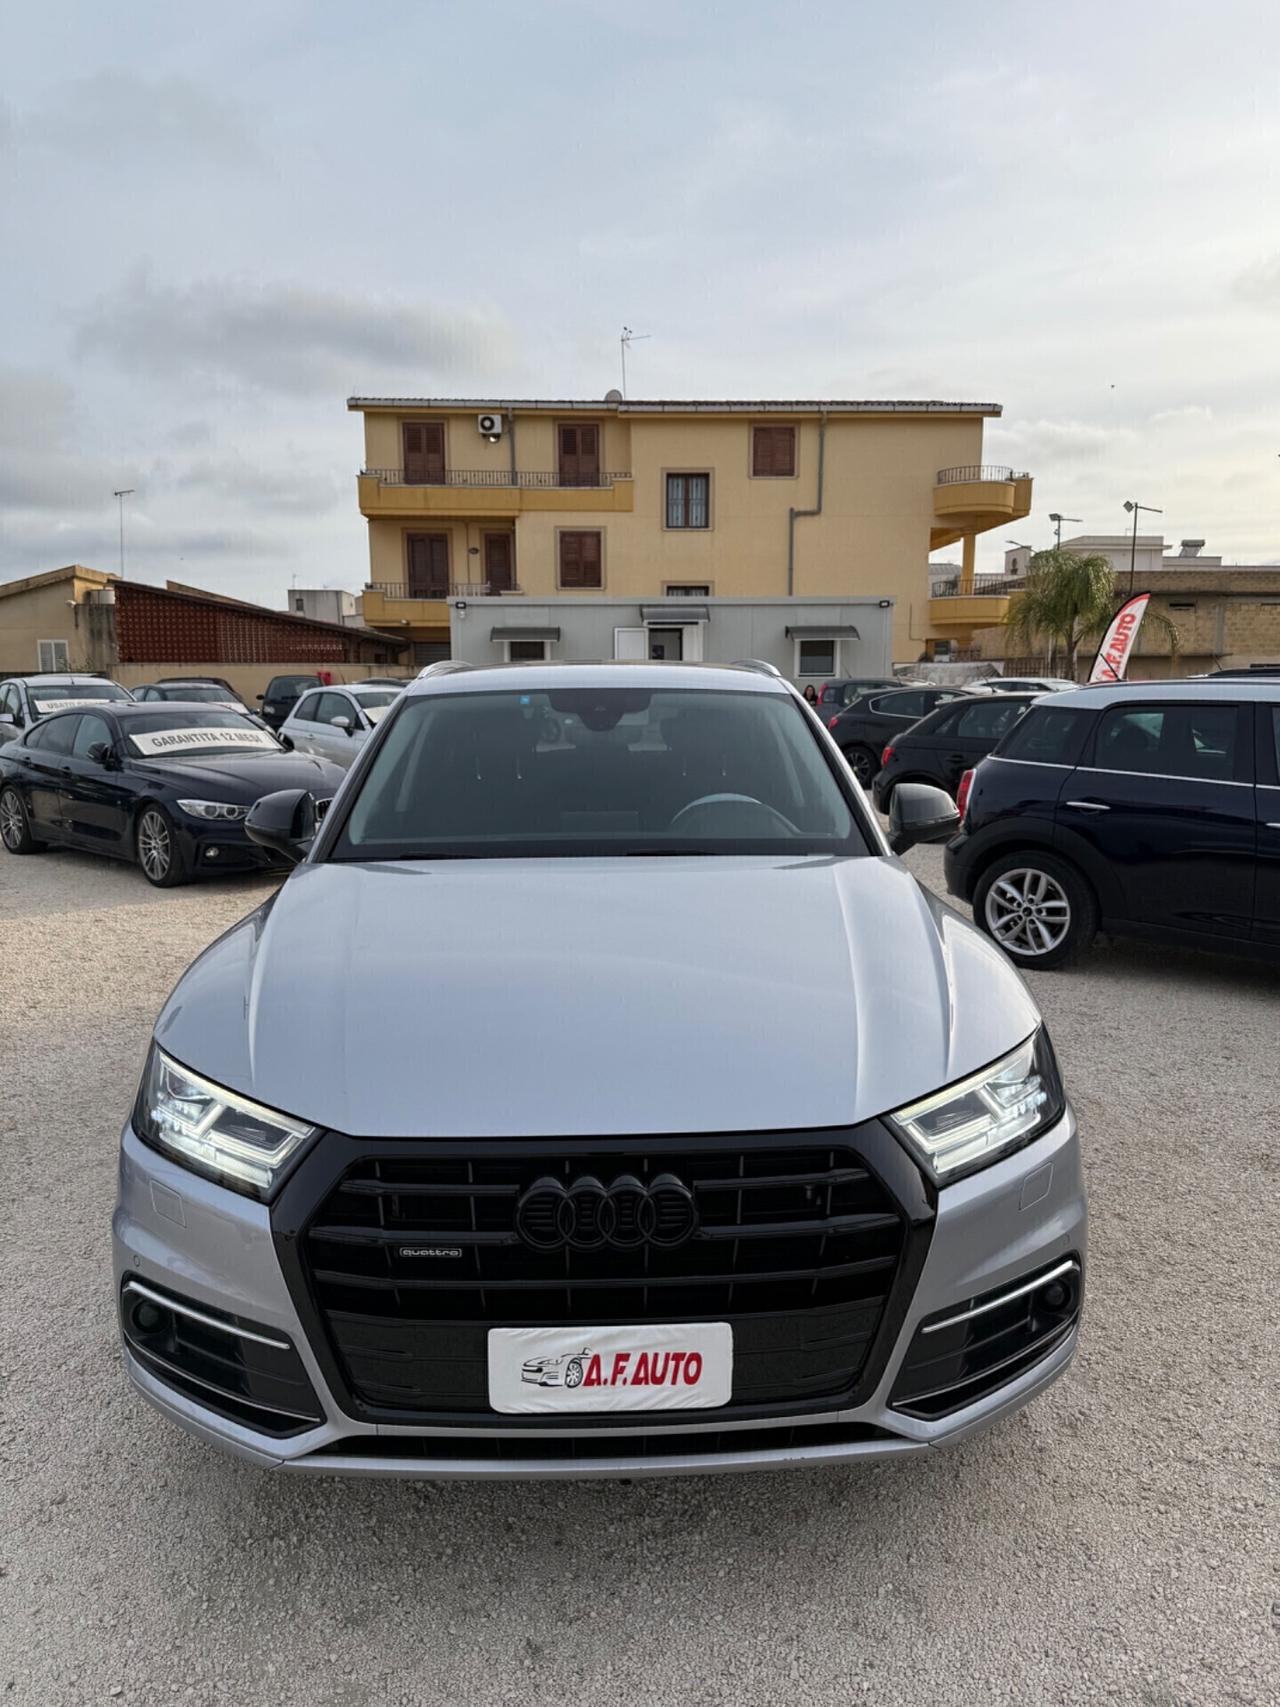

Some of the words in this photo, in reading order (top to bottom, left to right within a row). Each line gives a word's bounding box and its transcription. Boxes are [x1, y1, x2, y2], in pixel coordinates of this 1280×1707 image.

[151, 732, 220, 747] GARANTITA
[220, 732, 233, 742] 12
[234, 732, 263, 744] MESI
[402, 1249, 460, 1257] quattro
